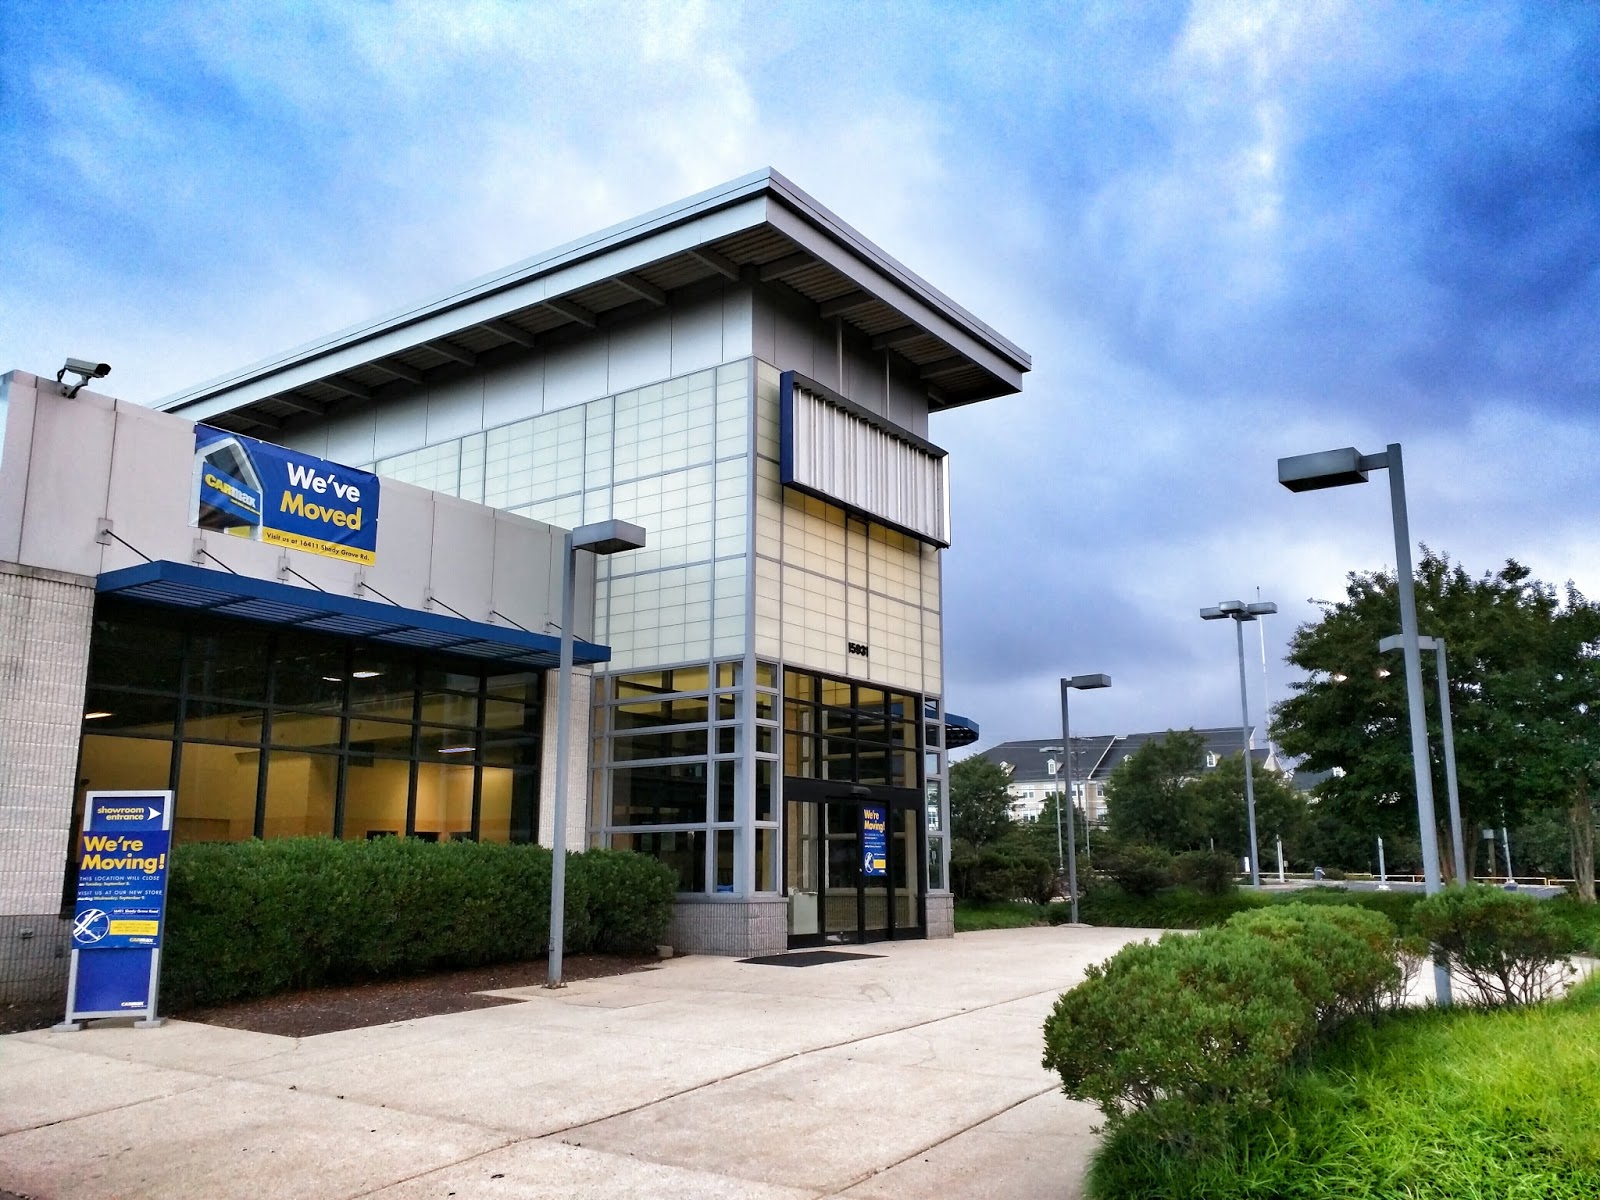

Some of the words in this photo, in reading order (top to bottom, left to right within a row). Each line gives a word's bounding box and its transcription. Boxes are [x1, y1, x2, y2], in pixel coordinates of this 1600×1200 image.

[287, 462, 360, 503] We've
[280, 490, 362, 531] Moved
[266, 532, 280, 540] Visit
[300, 540, 319, 549] 16411
[321, 545, 340, 555] Shady
[341, 549, 358, 558] Grove
[360, 553, 370, 561] Rd.
[97, 806, 144, 814] showroom
[864, 809, 879, 820] We're
[864, 820, 885, 833] Moving!
[84, 836, 143, 852] We're
[81, 853, 165, 874] Moving!
